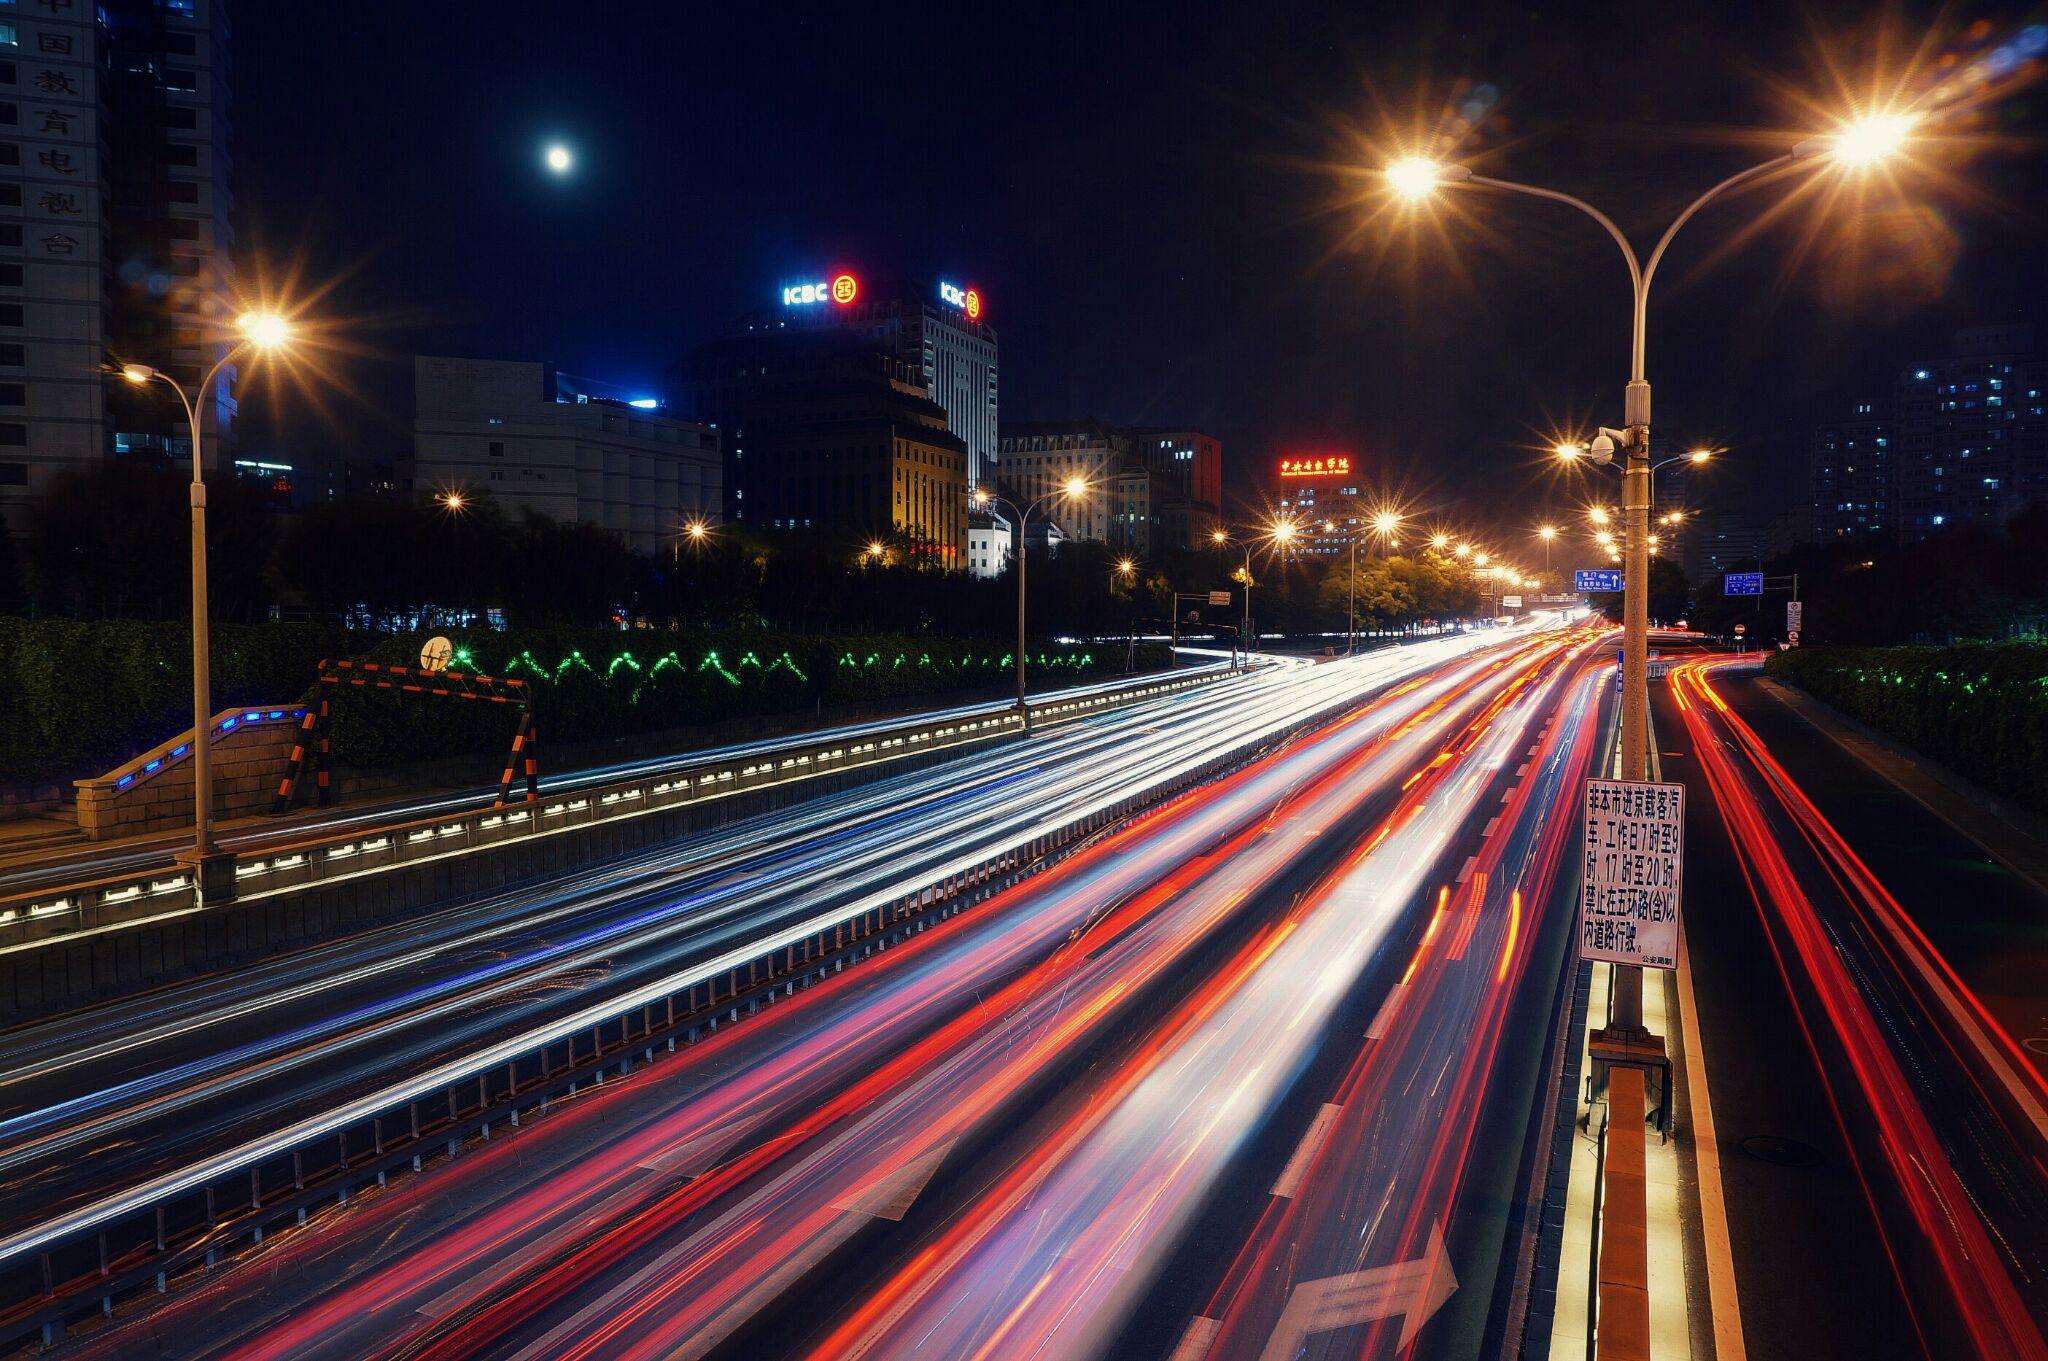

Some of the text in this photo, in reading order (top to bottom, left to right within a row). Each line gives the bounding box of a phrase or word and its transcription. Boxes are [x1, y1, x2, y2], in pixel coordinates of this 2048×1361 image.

[784, 283, 828, 305] ICBC
[941, 281, 966, 308] ICBC
[1589, 784, 1680, 821] 非本市进京载客汽
